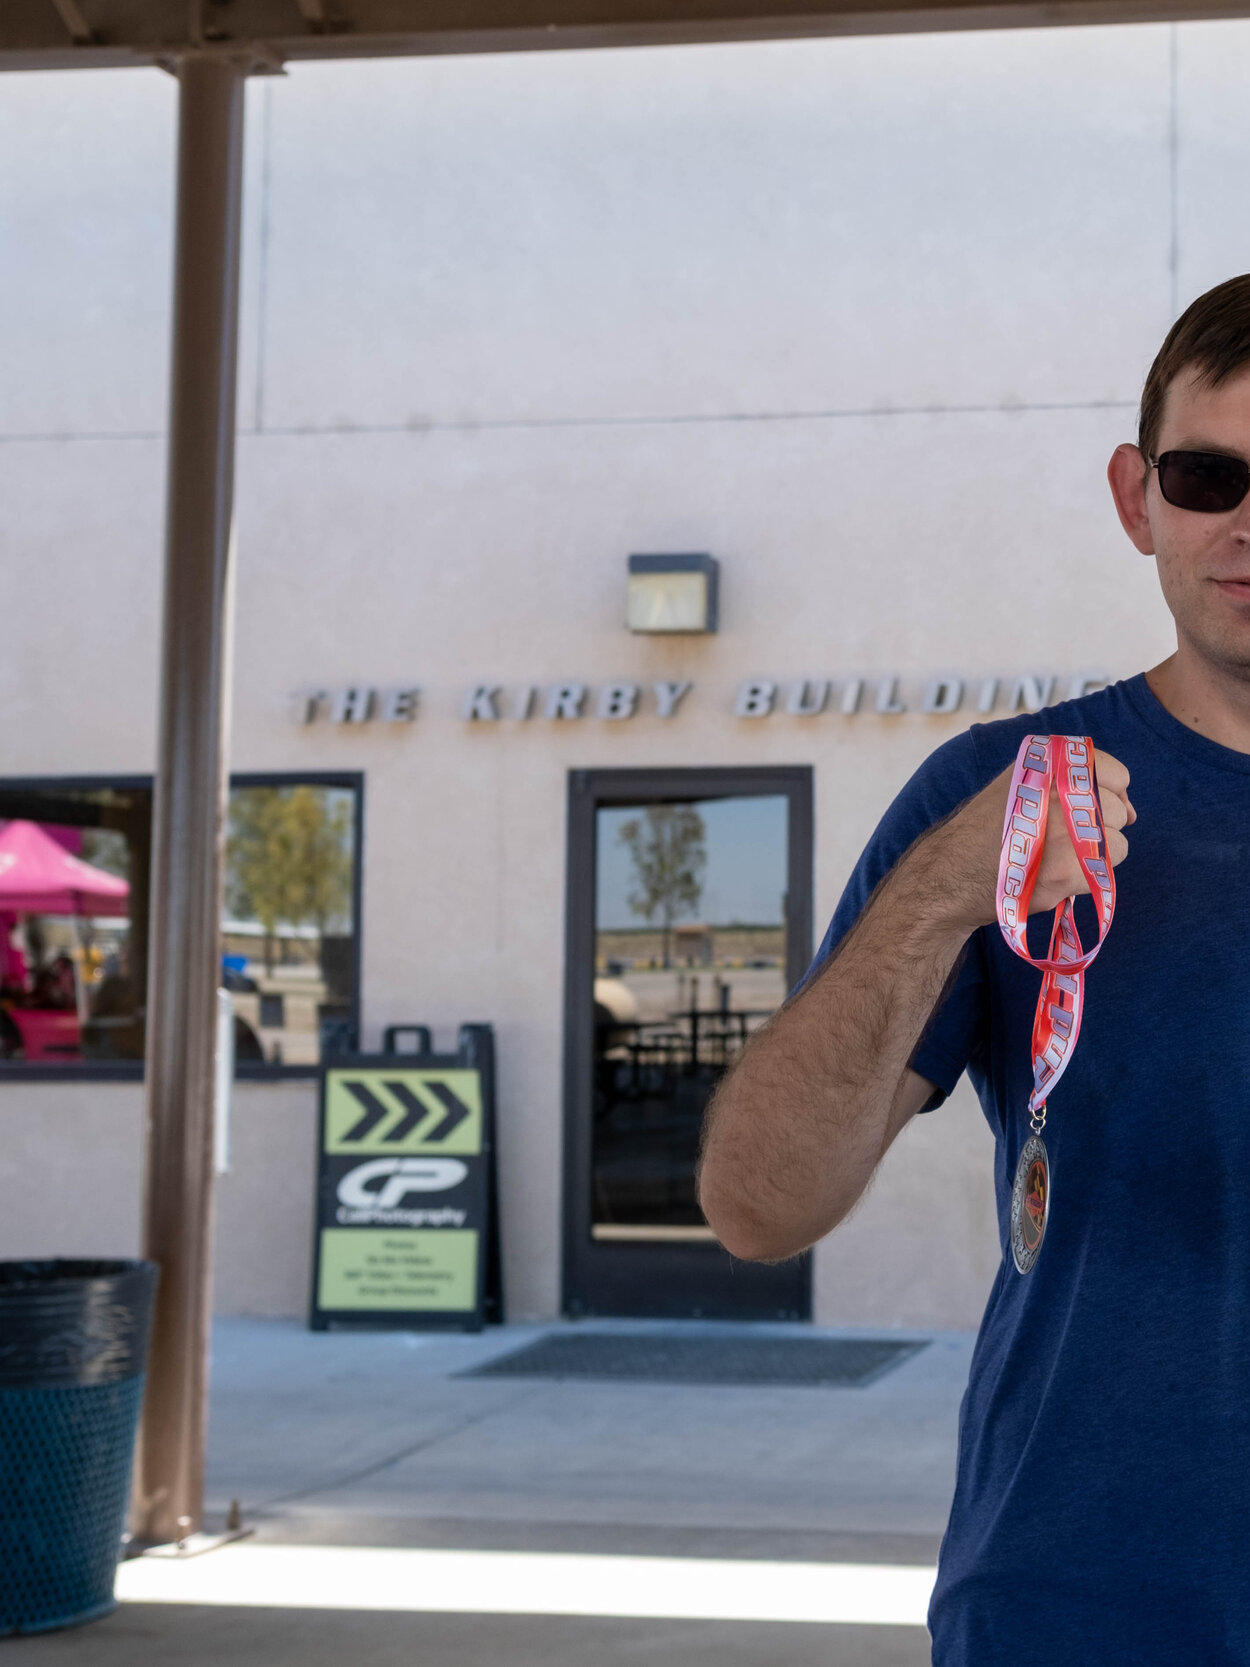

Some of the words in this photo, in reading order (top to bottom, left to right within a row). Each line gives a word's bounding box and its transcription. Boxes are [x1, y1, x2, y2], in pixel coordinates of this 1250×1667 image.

[288, 687, 421, 724] THE
[461, 681, 692, 723] KIRBY
[338, 1158, 468, 1209] CP
